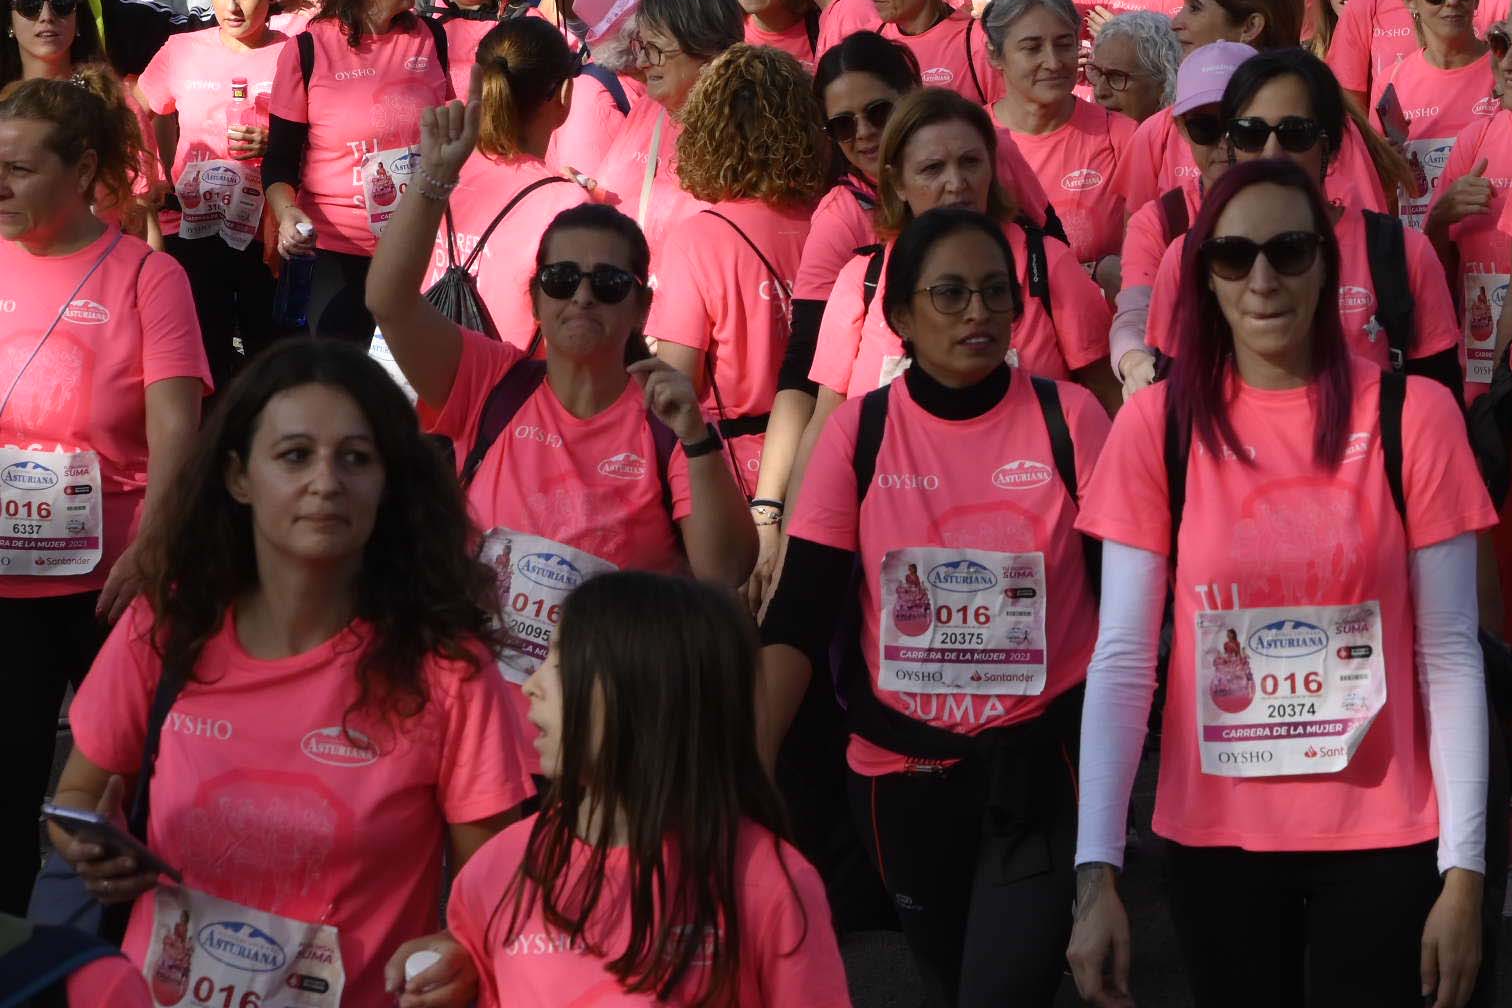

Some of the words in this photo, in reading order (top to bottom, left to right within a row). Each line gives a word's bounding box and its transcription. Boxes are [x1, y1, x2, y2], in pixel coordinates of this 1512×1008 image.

[335, 68, 377, 81] OYSHO
[5, 469, 55, 485] ASTURIANA
[997, 469, 1050, 483] ASTURIANA
[5, 500, 53, 519] 016
[12, 523, 42, 535] 6337
[12, 539, 24, 547] DE
[26, 539, 36, 547] LA
[37, 540, 66, 548] MUJER
[47, 557, 91, 566] Santander
[933, 568, 994, 586] ASTURIANA
[1003, 570, 1035, 579] SUMA
[512, 592, 560, 624] 016
[936, 604, 991, 626] 016
[510, 619, 552, 642] 20095
[1335, 623, 1370, 635] SUMA
[940, 632, 984, 646] 20375
[1255, 632, 1325, 650] ASTURIANA
[900, 650, 943, 661] CARRERA
[944, 650, 957, 661] DE
[959, 650, 972, 661] LA
[974, 651, 1006, 661] MUJER
[896, 669, 944, 682] OYSHO
[984, 671, 1034, 683] Santander
[1260, 672, 1323, 696] 016
[1267, 702, 1316, 719] 20374
[1223, 726, 1272, 739] CARRERA
[1274, 725, 1288, 737] DE
[1289, 724, 1304, 736] LA
[1306, 723, 1343, 736] MUJER
[307, 737, 373, 760] ASTURIANA
[1218, 750, 1273, 764] OYSHO
[202, 932, 278, 967] ASTURIANA
